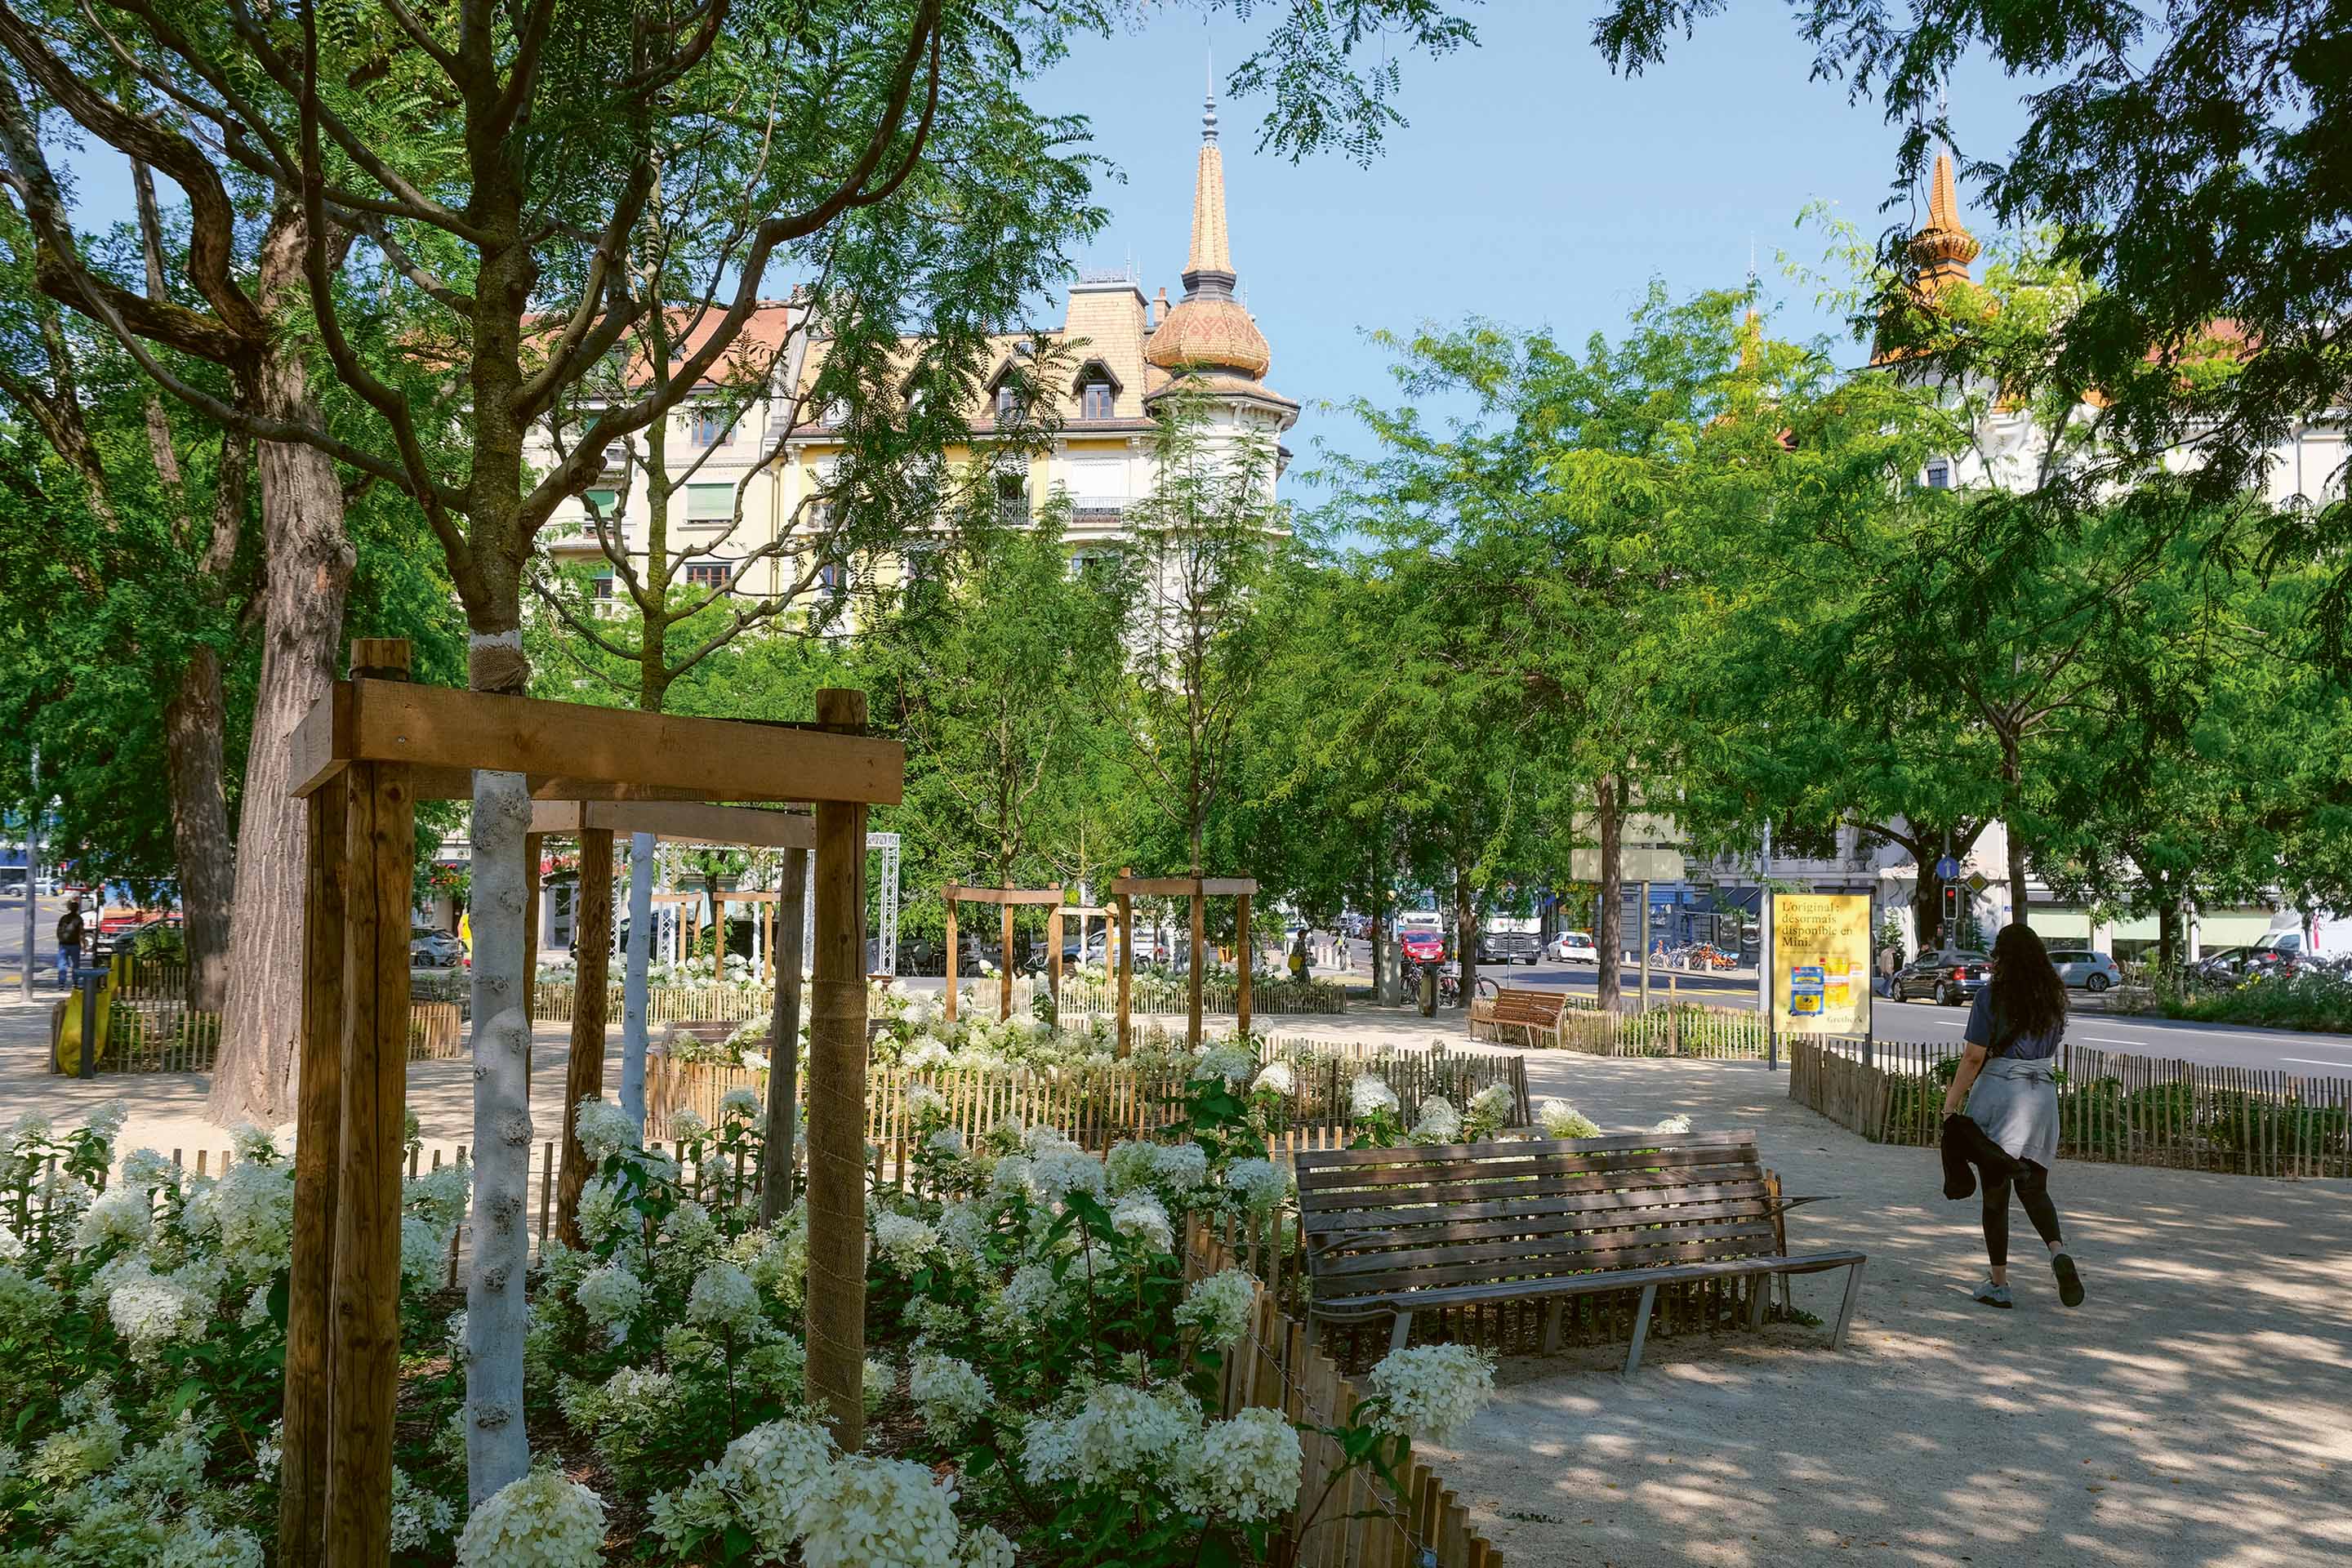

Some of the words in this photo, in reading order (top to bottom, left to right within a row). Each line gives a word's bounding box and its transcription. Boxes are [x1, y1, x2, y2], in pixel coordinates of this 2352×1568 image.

[1782, 914, 1837, 924] désormais
[1782, 925, 1837, 937] disponible
[1782, 937, 1811, 947] Mini.
